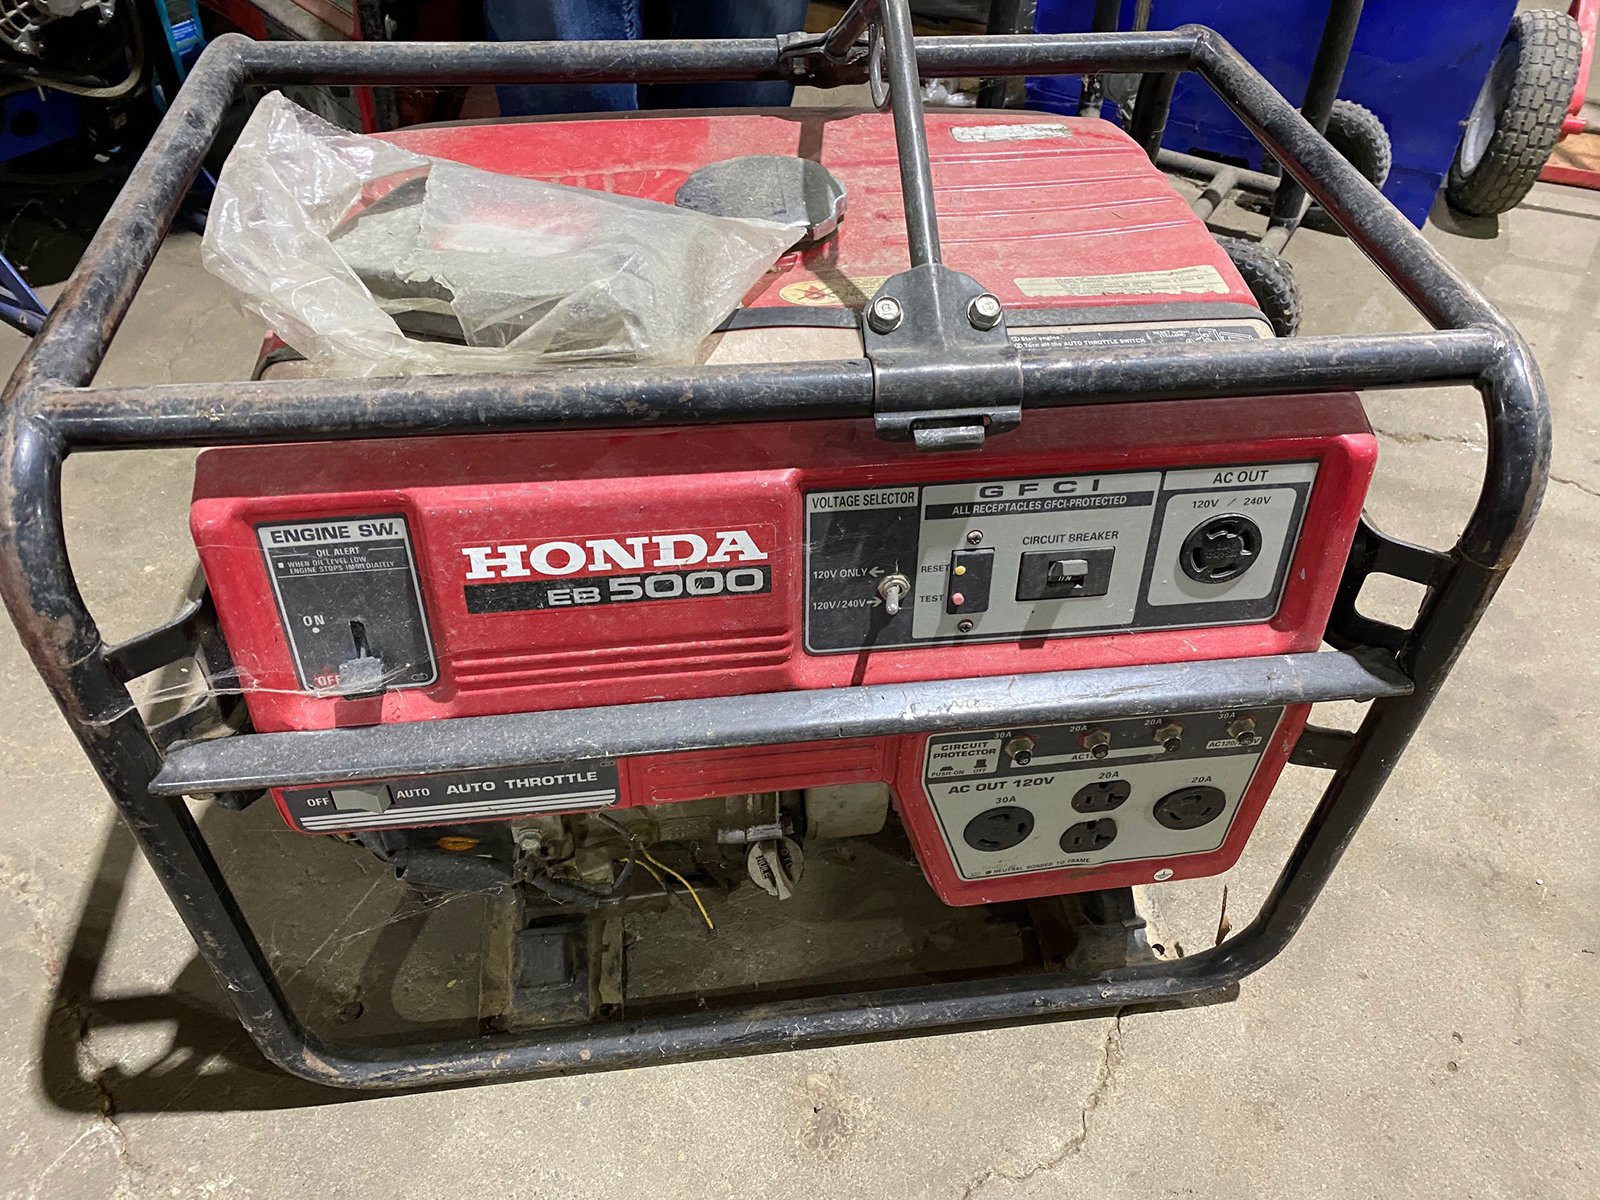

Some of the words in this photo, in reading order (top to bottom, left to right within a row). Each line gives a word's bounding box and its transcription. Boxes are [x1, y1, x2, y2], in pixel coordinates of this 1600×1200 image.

[1213, 471, 1232, 484] AC
[1237, 469, 1269, 482] OUT
[812, 494, 860, 509] VOLTAGE
[863, 491, 915, 506] SELECTOR
[952, 504, 970, 515] ALL
[973, 499, 1041, 514] RECEPTACLES
[1044, 495, 1127, 509] GFCI-PROTECTED
[1192, 499, 1219, 509] 120V
[1243, 496, 1272, 506] 240V
[270, 525, 351, 544] ENGINE
[358, 522, 399, 538] SW.
[1022, 534, 1066, 546] CIRCUIT
[1068, 530, 1119, 543] BREAKER
[316, 548, 331, 557] OIL
[334, 546, 360, 556] ALERT
[461, 530, 768, 579] HONDA
[287, 560, 310, 568] WHEN
[350, 556, 367, 564] LOW
[289, 567, 317, 575] ENGINE
[319, 564, 343, 573] STOPS
[345, 560, 395, 570] IMMEDIATELY
[813, 570, 836, 580] 120V
[839, 568, 868, 578] ONLY
[920, 564, 950, 574] RESET
[547, 586, 600, 606] EB
[609, 568, 764, 601] 5000
[812, 599, 867, 610] 120V/240V
[919, 594, 944, 603] TEST
[302, 614, 325, 627] ON
[316, 675, 341, 687] OFF
[1218, 711, 1236, 720] 30A
[1144, 718, 1162, 726] 20A
[1069, 724, 1088, 733] 20A
[993, 731, 1012, 740] 30A
[941, 741, 989, 751] CIRCUIT
[933, 748, 997, 760] PROTECTOR
[1098, 771, 1120, 780] 20A
[1191, 775, 1213, 785] 20A
[396, 787, 431, 799] AUTO
[446, 780, 497, 795] AUTO
[503, 771, 598, 789] THROTTLE
[948, 785, 970, 795] AC
[975, 780, 1008, 792] OUT
[1012, 776, 1055, 788] 120V
[306, 797, 330, 807] OFF
[995, 795, 1017, 804] 30A
[993, 866, 1023, 874] NEUTRAL
